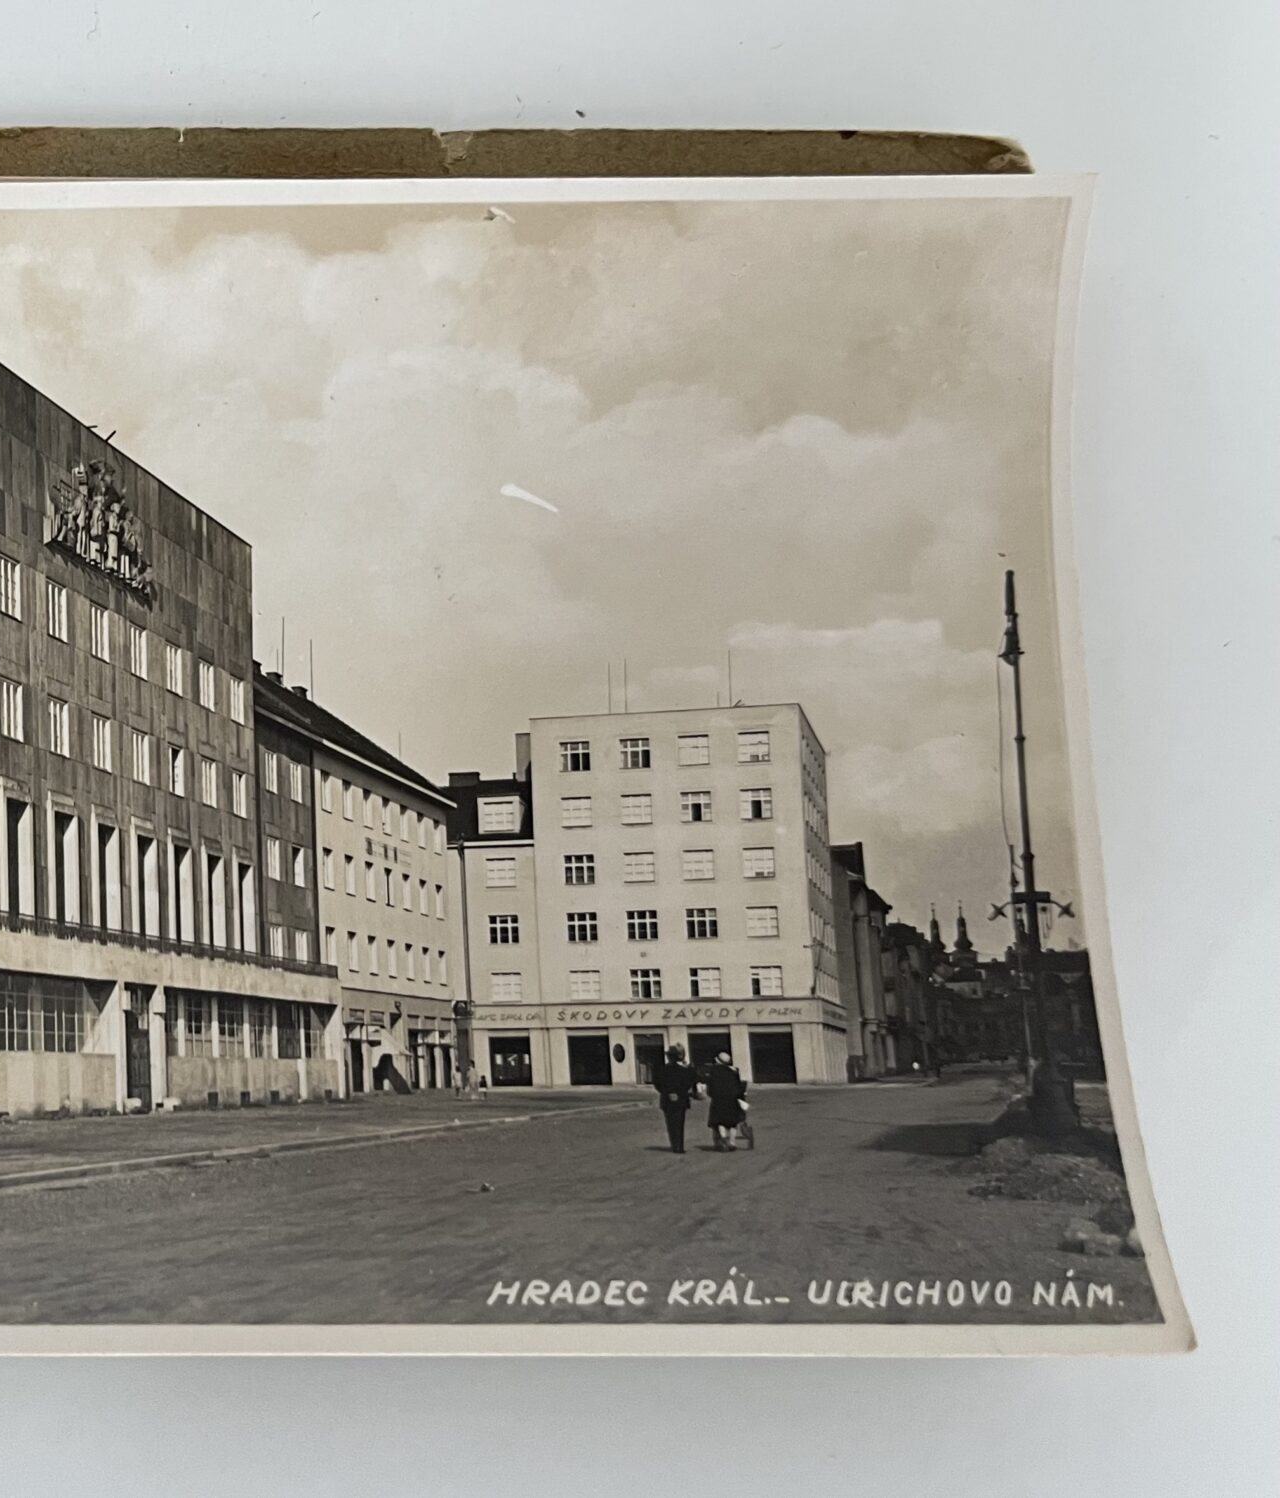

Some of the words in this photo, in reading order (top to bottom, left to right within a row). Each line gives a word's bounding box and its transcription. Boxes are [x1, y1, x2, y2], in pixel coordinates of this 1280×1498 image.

[556, 1008, 649, 1022] ŠKODOVY
[486, 1279, 648, 1305] HRADEC
[807, 1279, 1012, 1308] ULRICHOVO
[1032, 1269, 1124, 1308] NÁM.
